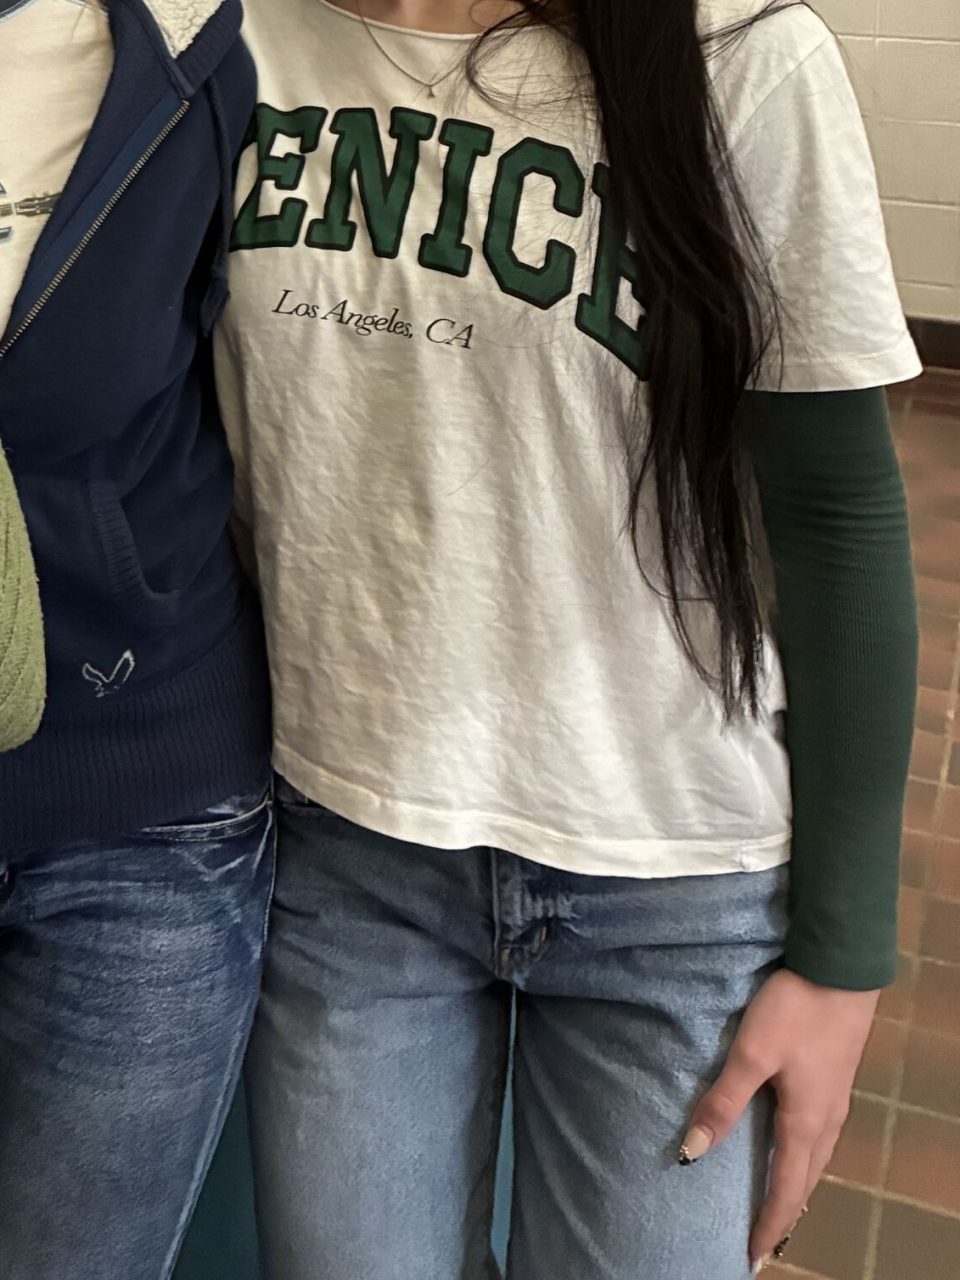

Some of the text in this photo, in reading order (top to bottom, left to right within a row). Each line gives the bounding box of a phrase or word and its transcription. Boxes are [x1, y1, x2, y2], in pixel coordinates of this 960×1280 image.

[229, 104, 648, 381] ENICE
[271, 289, 474, 350] Los Angeles, CA
